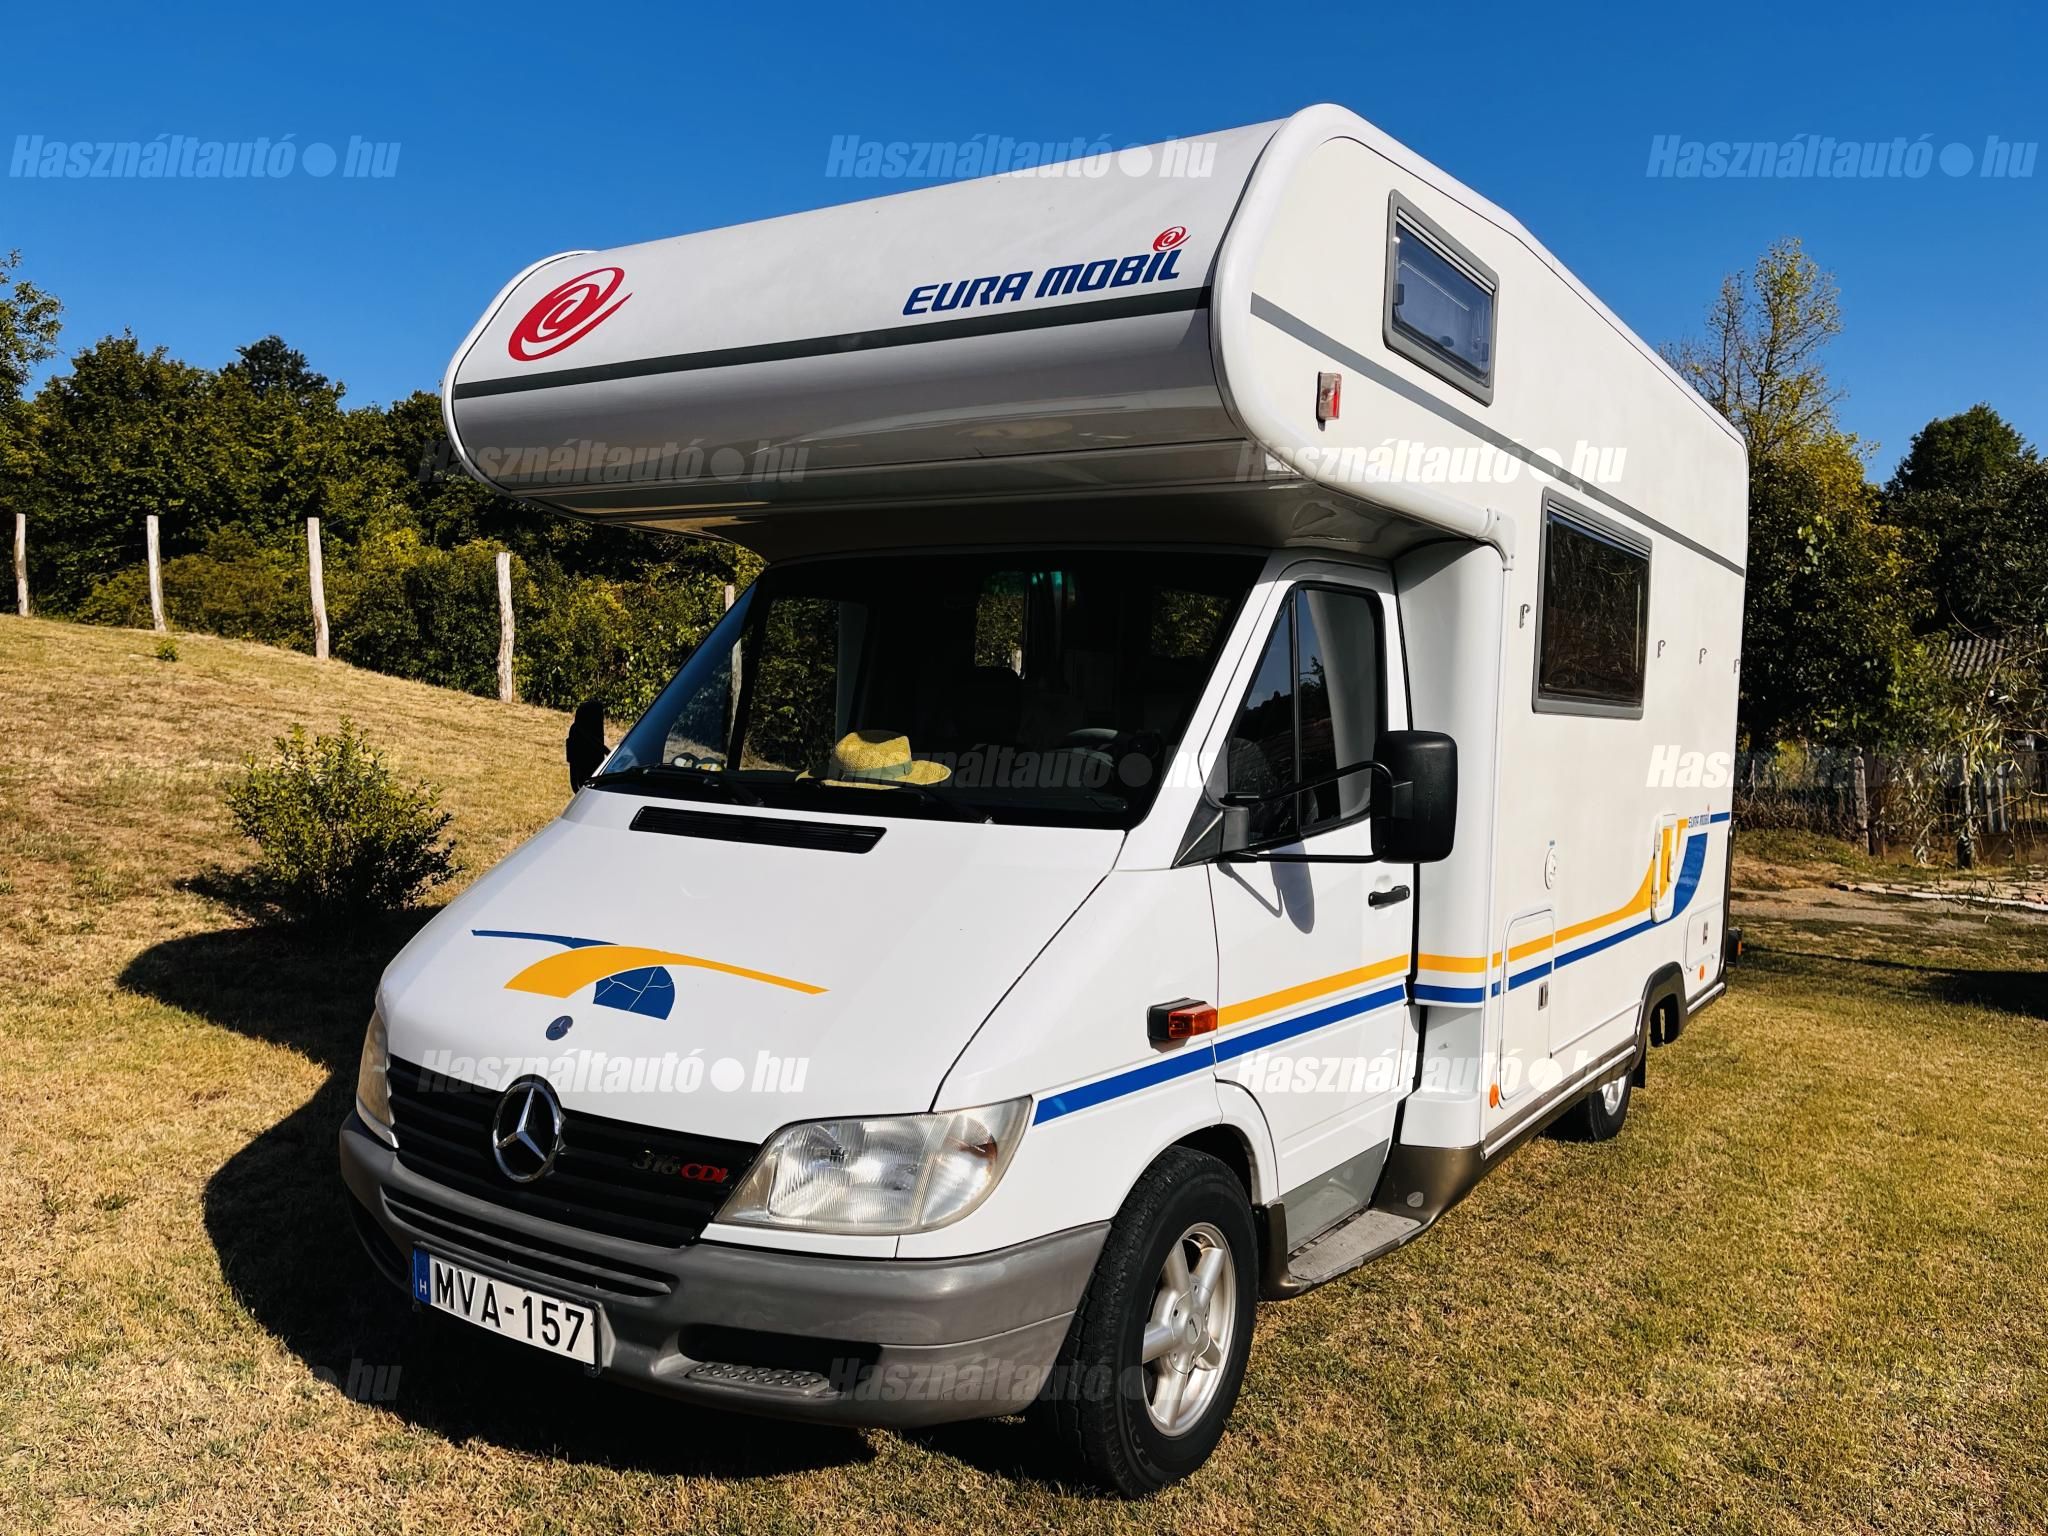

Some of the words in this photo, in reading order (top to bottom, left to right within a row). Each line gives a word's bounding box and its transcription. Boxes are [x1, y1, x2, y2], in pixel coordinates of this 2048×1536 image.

[902, 270, 1033, 316] EURA
[1034, 248, 1183, 299] MOBIL
[419, 1280, 428, 1295] H
[435, 1259, 585, 1353] MVA-157
